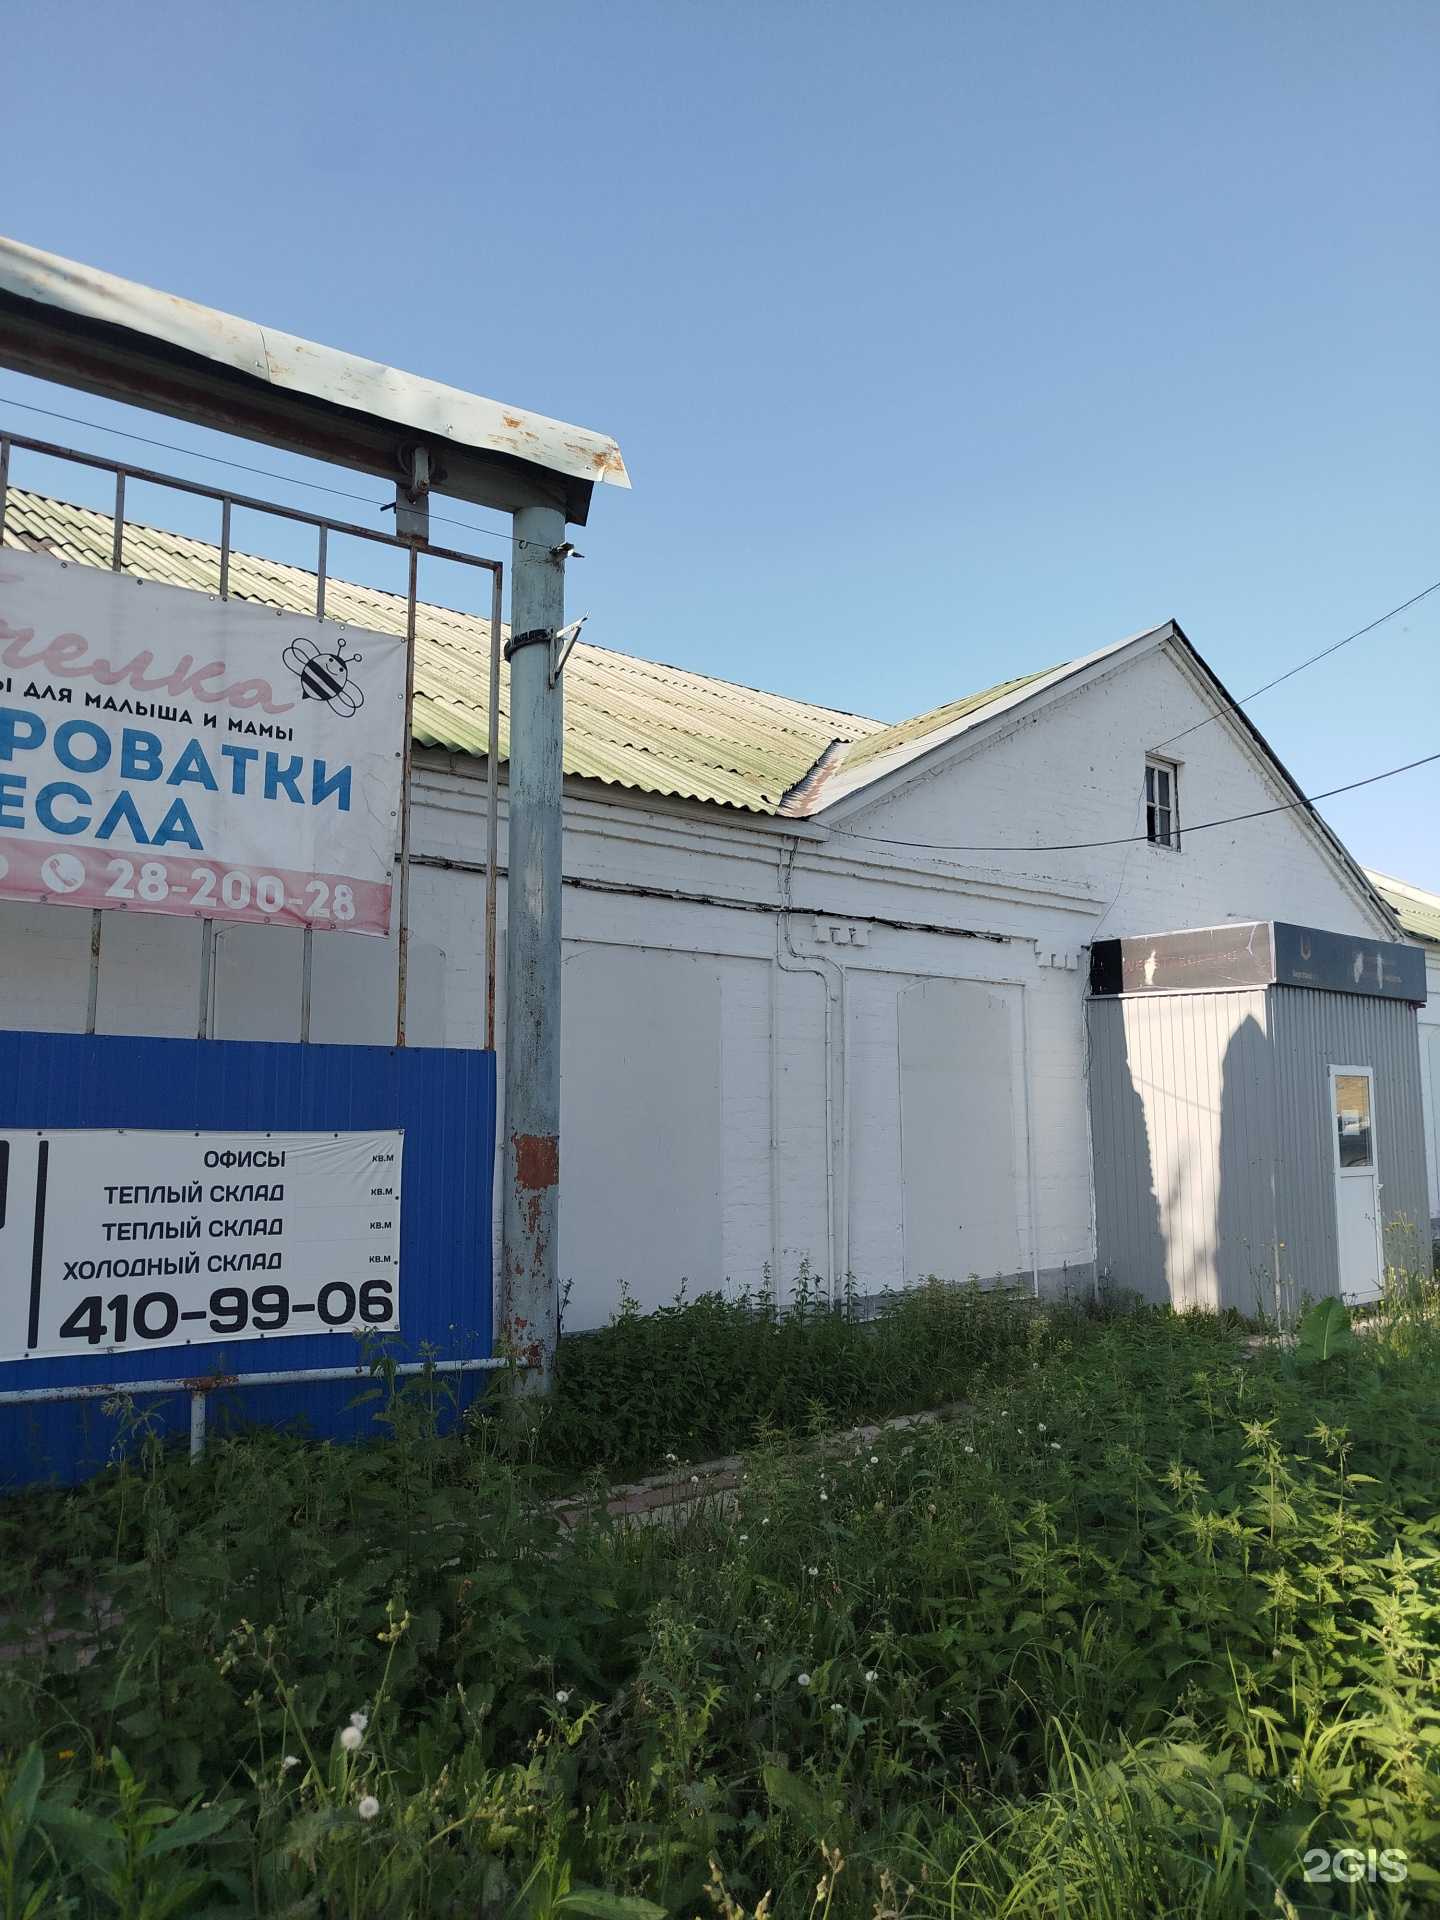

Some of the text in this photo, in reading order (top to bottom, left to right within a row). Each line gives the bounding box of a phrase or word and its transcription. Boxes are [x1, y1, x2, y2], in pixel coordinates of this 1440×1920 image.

[0, 617, 295, 714] челка
[23, 682, 72, 704] ДЛЯ
[85, 692, 193, 725] МАЛЫША
[203, 713, 217, 729] И
[228, 720, 294, 742] МАМЫ
[0, 707, 353, 812] РОВАТКИ
[0, 773, 204, 851] ЕСЛА
[105, 859, 356, 921] 28-200-28
[203, 1150, 286, 1169] ОФИСЫ
[104, 1180, 202, 1204] ТЕПЛЫЙ
[209, 1184, 284, 1202] СКЛАД
[102, 1216, 201, 1241] ТЕПЛЫЙ
[208, 1218, 283, 1237] СКЛАД
[63, 1251, 200, 1280] ХОЛОДНЫЙ
[207, 1252, 282, 1272] СКЛАД
[59, 1279, 393, 1345] 410-99-06
